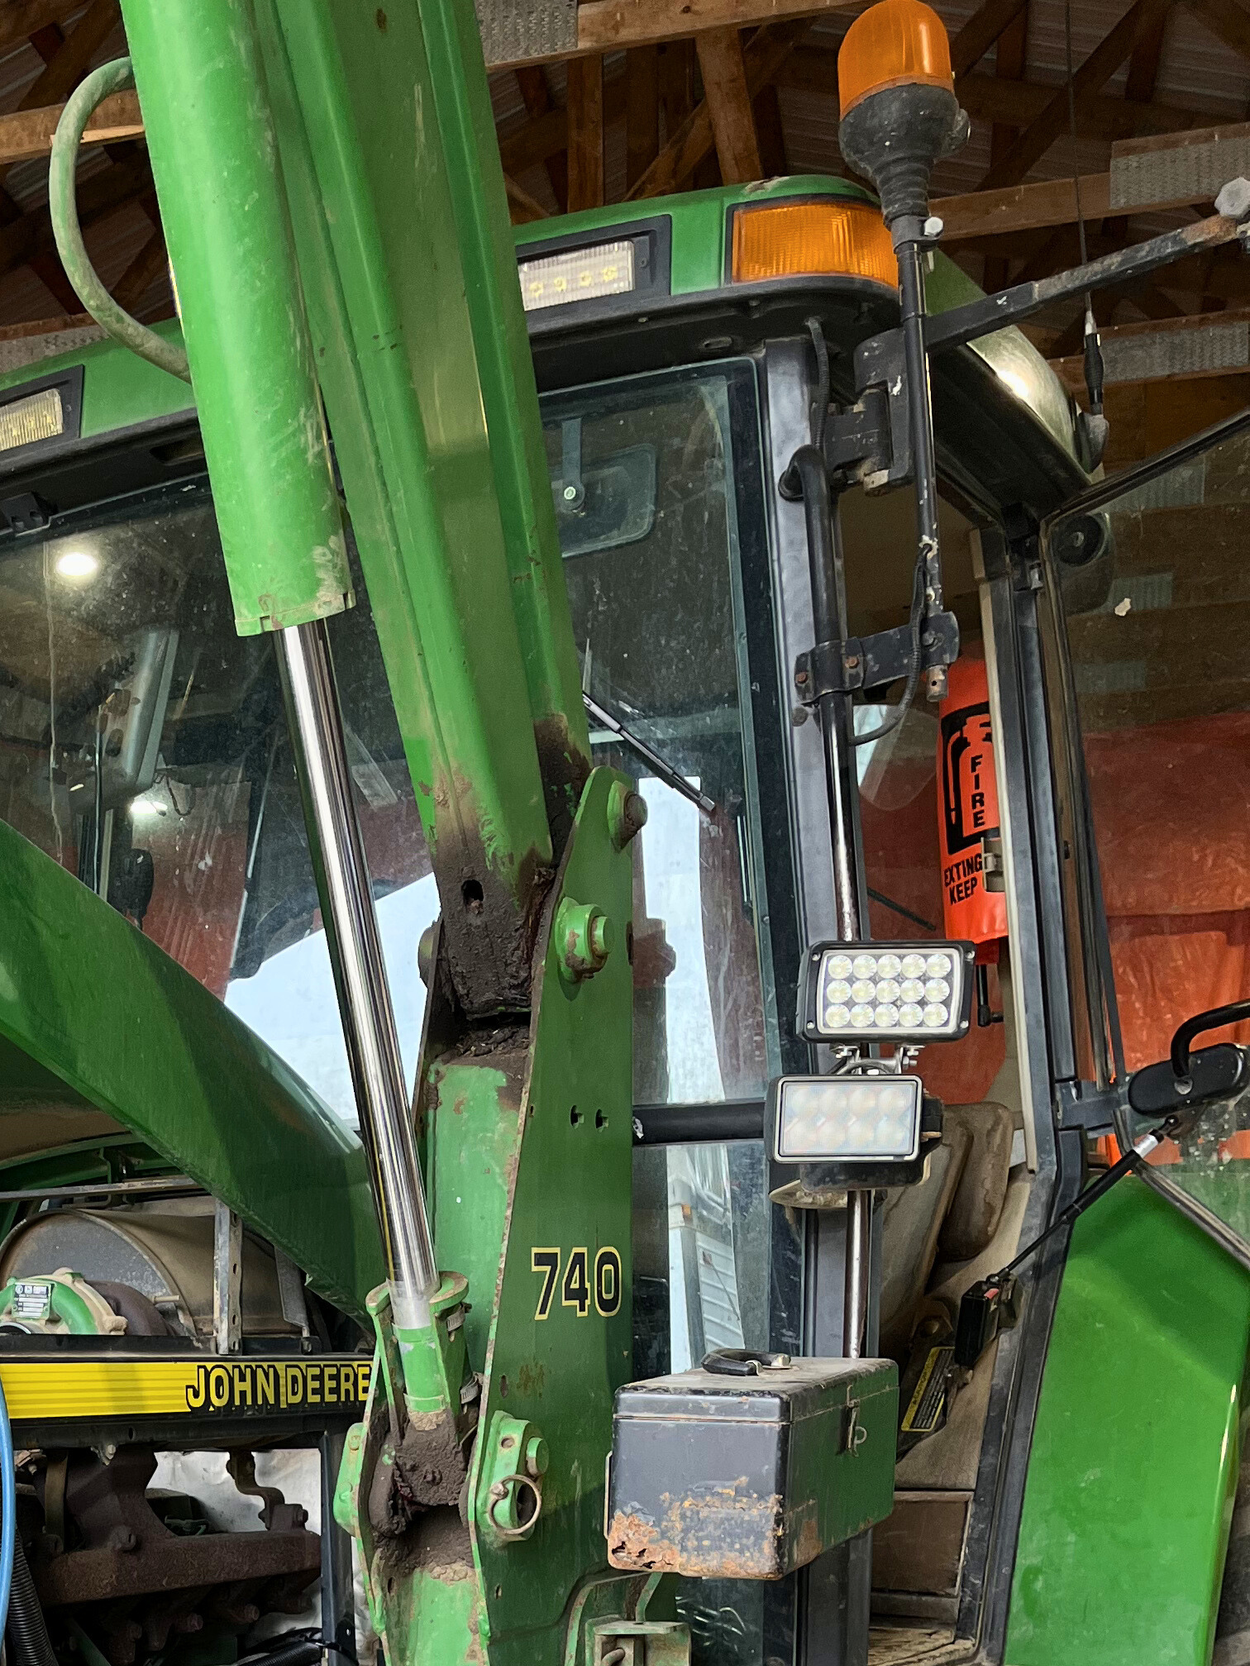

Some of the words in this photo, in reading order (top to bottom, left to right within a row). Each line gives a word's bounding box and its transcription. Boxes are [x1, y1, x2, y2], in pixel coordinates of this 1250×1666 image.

[970, 754, 985, 828] FIRE
[948, 875, 979, 906] KEEP
[531, 1246, 622, 1321] 740
[186, 1365, 276, 1409] JOHN
[286, 1365, 371, 1405] DEERE
